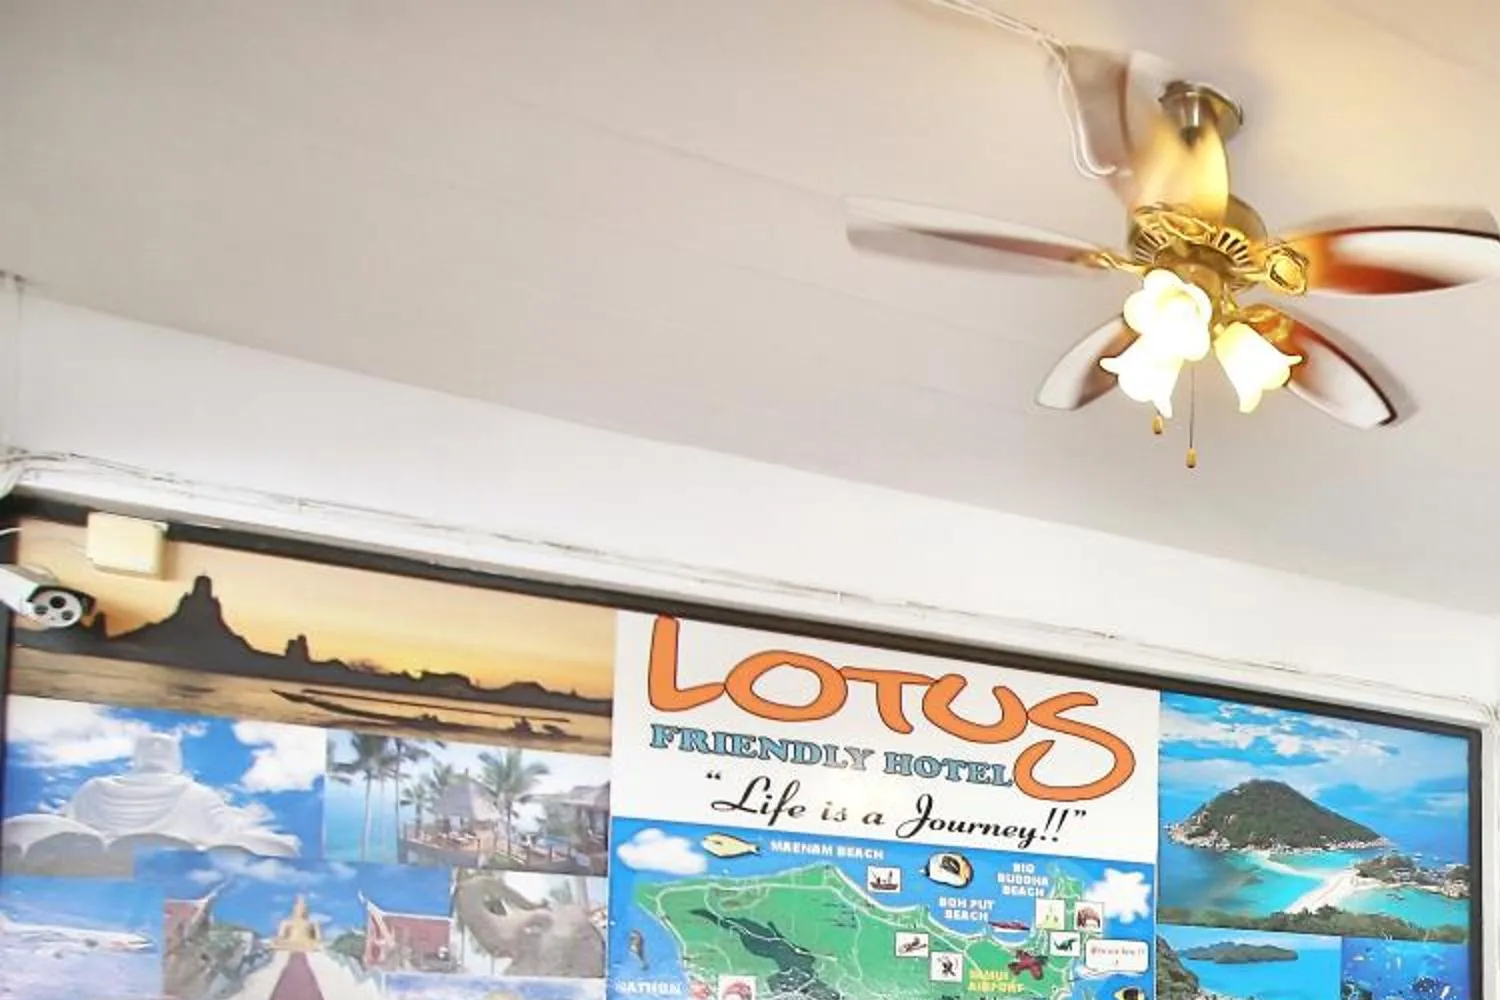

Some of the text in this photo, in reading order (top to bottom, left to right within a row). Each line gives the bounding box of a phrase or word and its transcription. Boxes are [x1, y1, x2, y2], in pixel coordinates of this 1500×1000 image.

[648, 614, 1136, 801] LOTUS
[649, 724, 1013, 787] FRIENDLY HOTEL
[821, 800, 849, 823] is
[864, 809, 885, 826] a
[837, 845, 885, 860] BEACH
[997, 872, 1049, 887] BUDDHA
[1002, 884, 1045, 898] BEACH
[944, 908, 989, 922] BEACH
[968, 980, 1025, 993] AIRPORT
